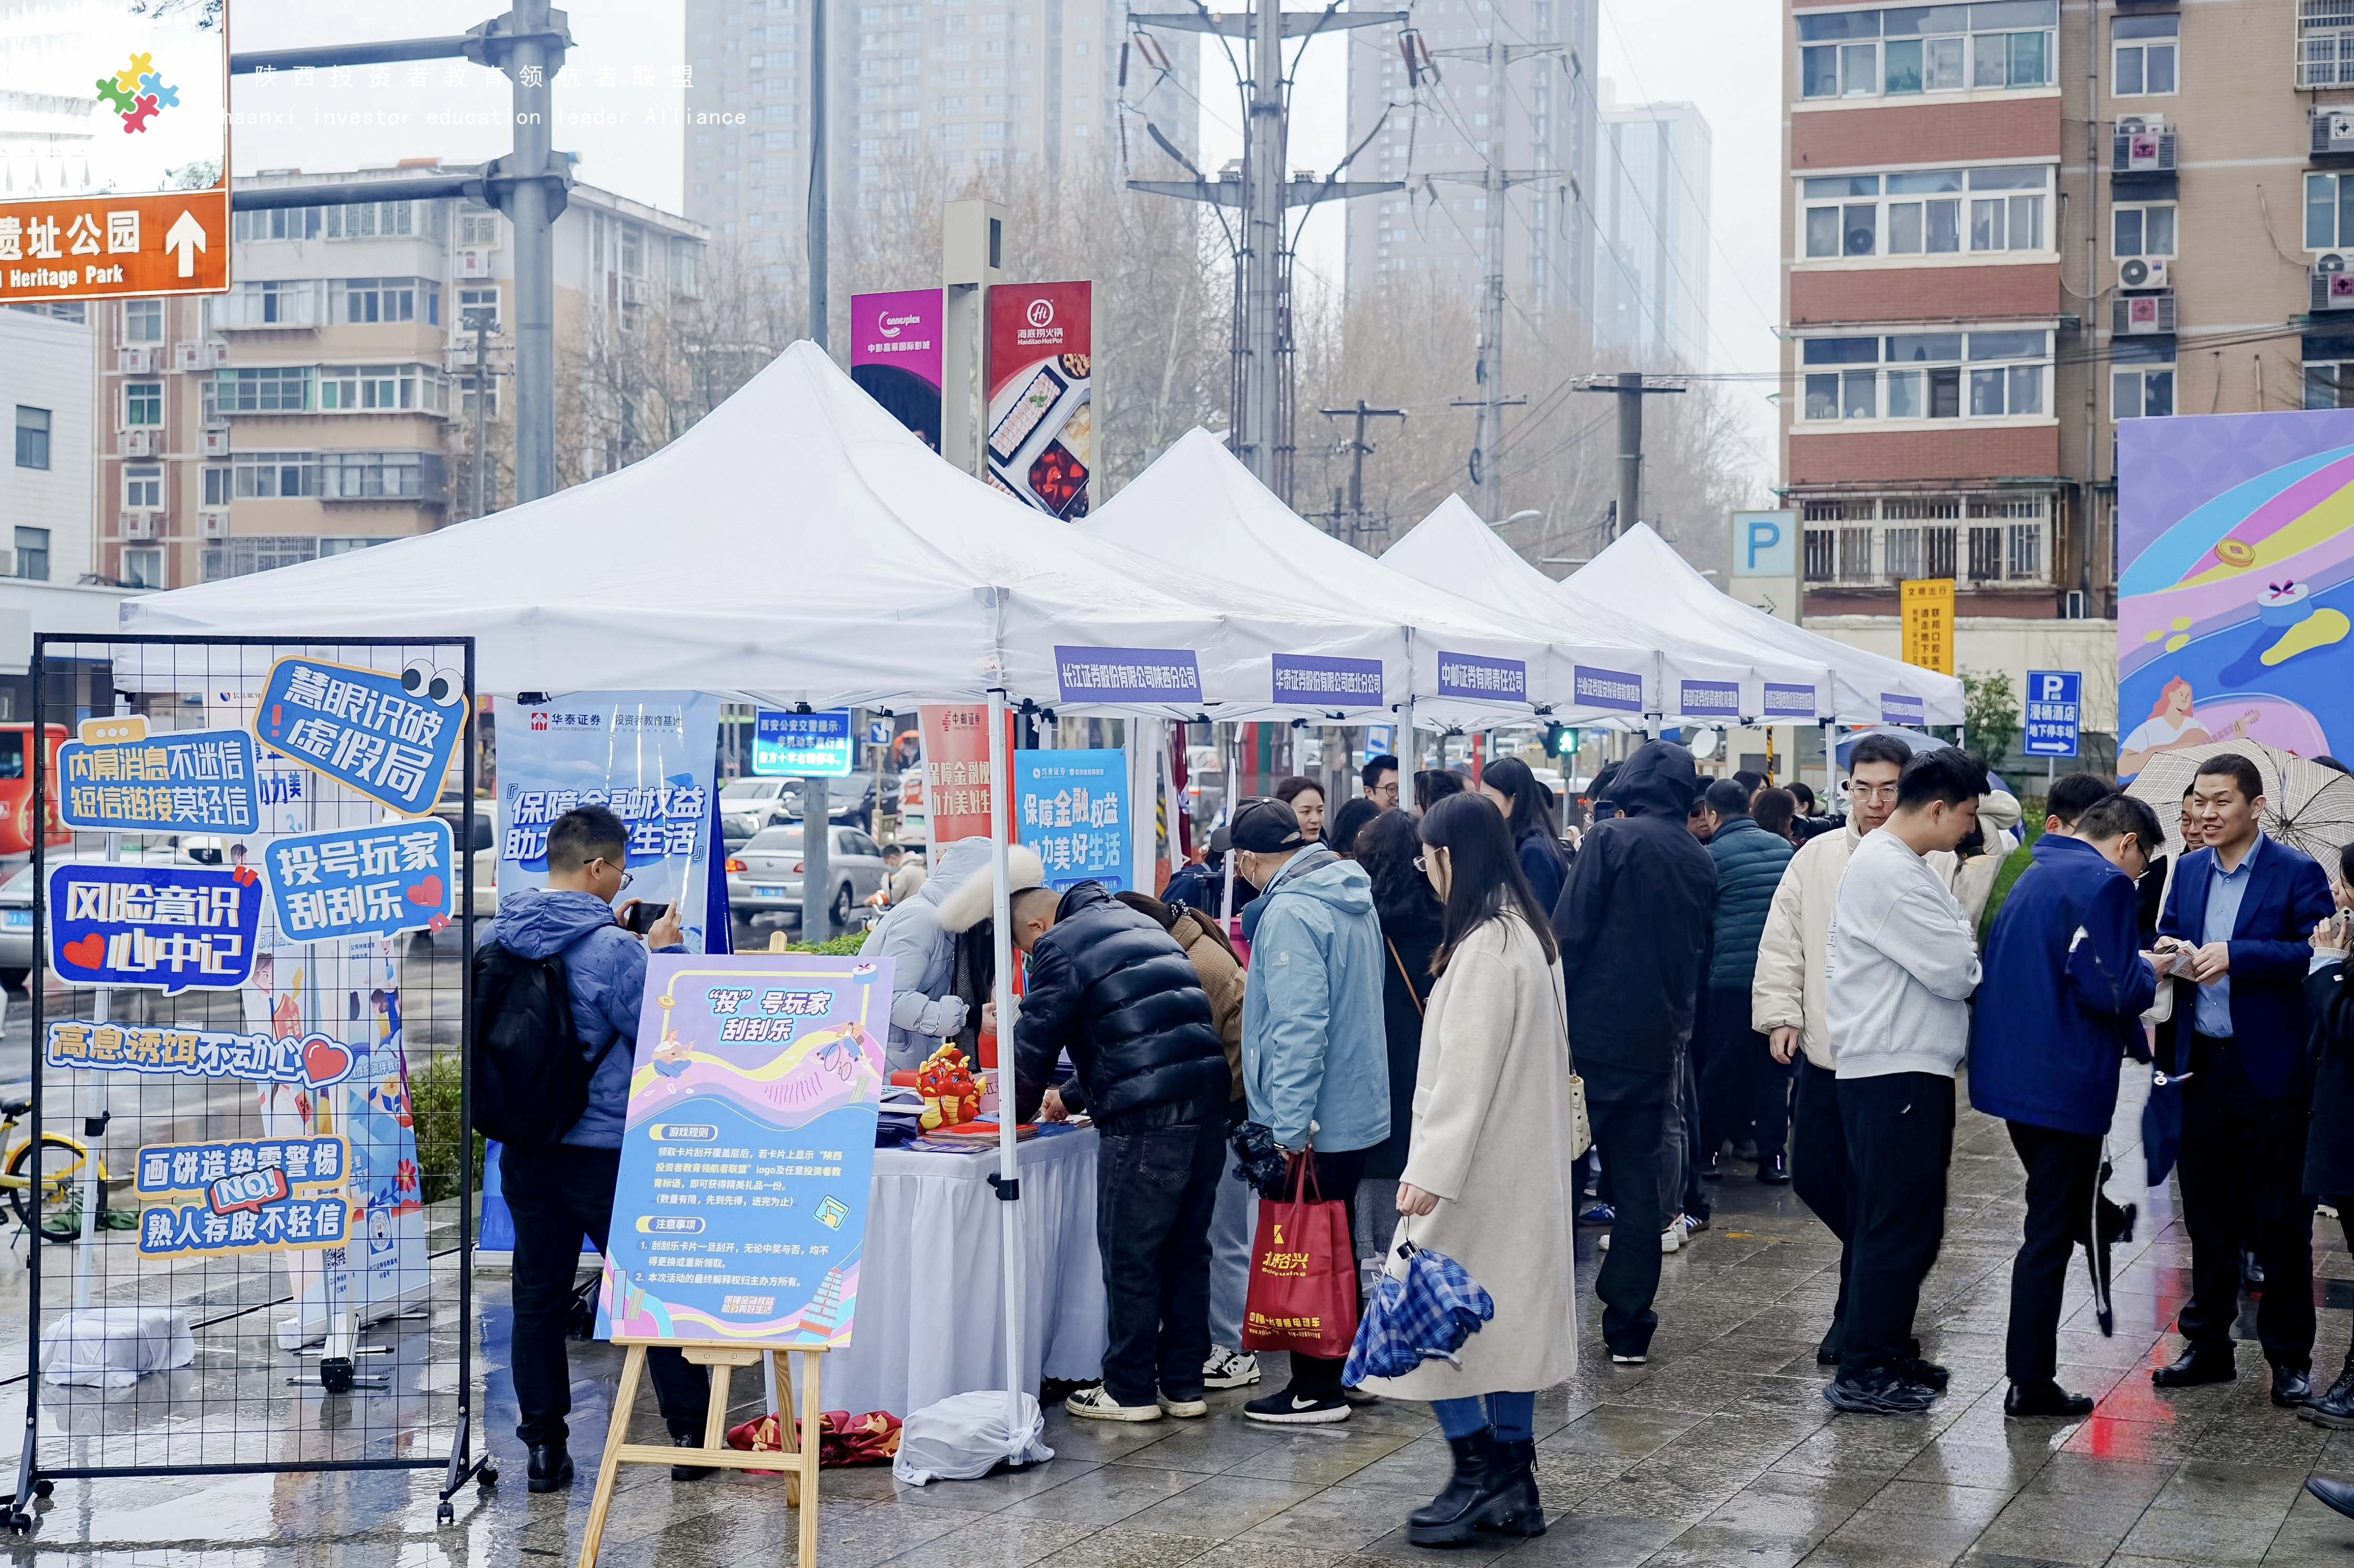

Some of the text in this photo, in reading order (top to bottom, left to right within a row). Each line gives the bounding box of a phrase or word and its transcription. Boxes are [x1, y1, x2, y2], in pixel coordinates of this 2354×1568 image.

[11, 269, 78, 289] Heritage
[86, 264, 124, 284] Park
[1017, 328, 1064, 339] 海底捞火锅
[1748, 522, 1780, 569] P
[1908, 585, 1946, 597] 文明出行
[1932, 608, 1940, 672] 联邦口腔医
[1062, 663, 1197, 689] 长江证券股份有限公司陕西分公司
[1275, 668, 1380, 694] 华泰证券股份有限公司西北分公司
[1441, 662, 1523, 693] 中邮证券有限责任公司
[2043, 675, 2064, 701] P
[284, 665, 444, 751] 慧眼识破
[1682, 689, 1738, 708] 西部证券投资者教育基地
[552, 714, 601, 725] 华泰证券
[952, 712, 980, 726] 中邮证券
[2029, 723, 2074, 739] 地下停车场
[69, 740, 244, 782] 内幕消息不迷信
[286, 718, 435, 803] 虚假局
[70, 786, 250, 826] 短信链接莫轻信
[1023, 787, 1119, 829] 保障金融权益
[276, 832, 439, 888] 投号玩家
[66, 881, 240, 928] 风险意识
[286, 880, 404, 932] 刮刮乐
[106, 928, 243, 975] 心中记
[721, 1017, 794, 1042] 刮刮乐
[54, 1026, 303, 1074] 高息诱饵不动心
[668, 1127, 709, 1138] 游戏规则
[218, 1169, 278, 1207] NO!
[147, 1203, 340, 1247] 熟人荐股不轻信
[655, 1219, 696, 1231] 注意事项
[648, 1256, 726, 1269] 得更换或重新领取。
[725, 1295, 776, 1305] 保障金融权益
